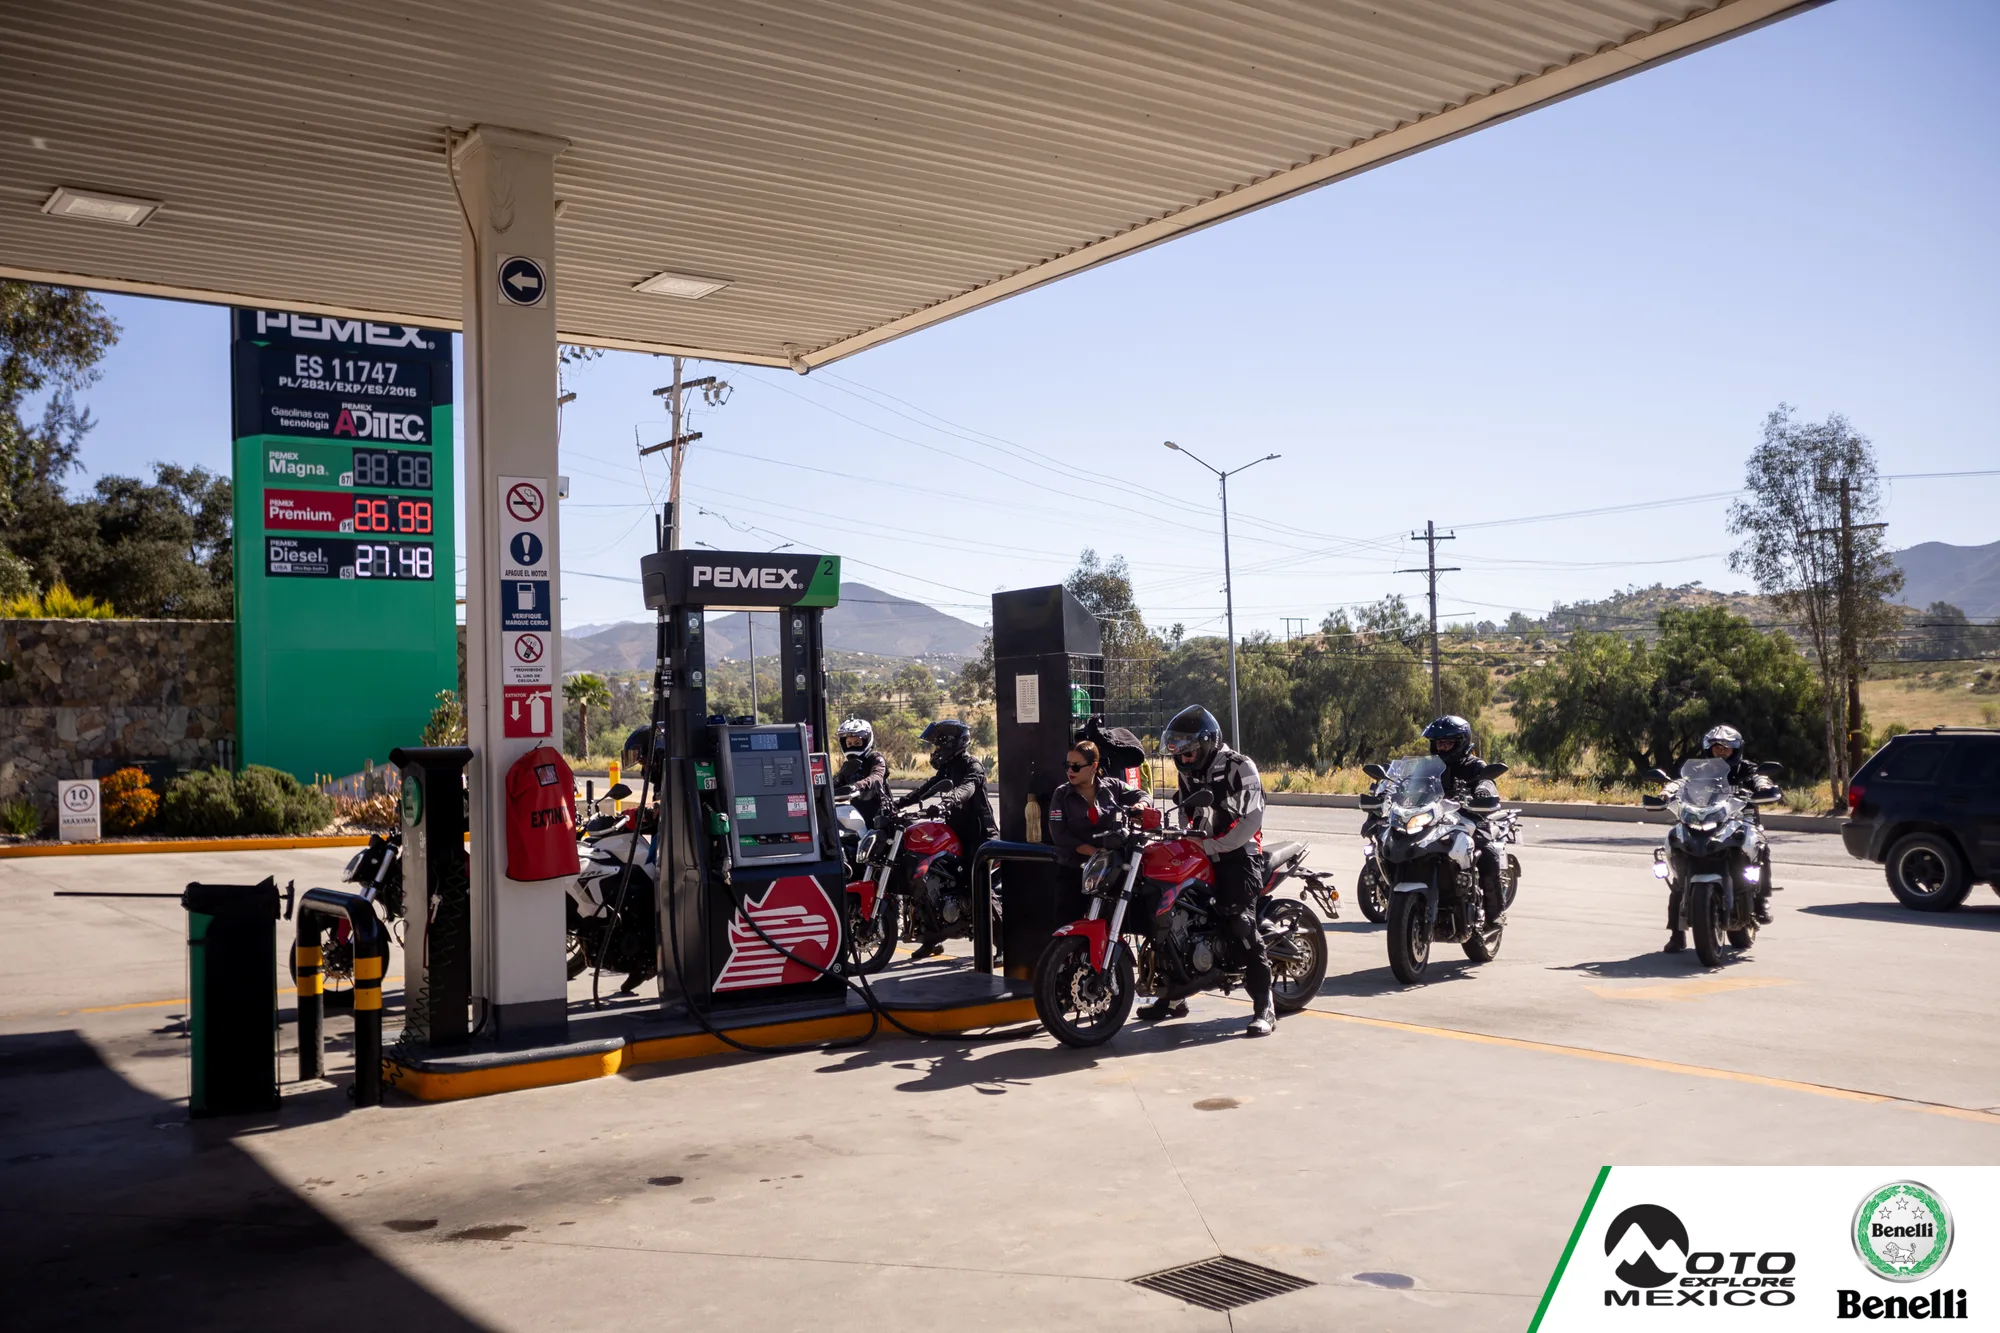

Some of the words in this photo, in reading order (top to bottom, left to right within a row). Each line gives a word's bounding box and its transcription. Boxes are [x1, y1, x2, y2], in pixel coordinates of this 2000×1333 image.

[257, 311, 427, 349] PEMEX
[295, 354, 323, 378] ES
[332, 358, 398, 384] 11747
[278, 376, 417, 398] PL/2821/EXP/ES/2015
[271, 406, 313, 419] Gasolinas
[314, 412, 329, 420] con
[342, 402, 372, 411] PEMEX
[268, 451, 299, 460] PEMEX
[268, 459, 325, 477] Magna
[269, 498, 294, 507] PEMEX
[269, 506, 332, 522] Premium
[355, 499, 432, 533] 26.99
[270, 539, 298, 548] PEMEX
[270, 547, 322, 563] Diesel
[355, 545, 433, 579] 27.48
[505, 569, 524, 577] APAGUE
[531, 570, 548, 578] MOTOR
[823, 560, 834, 576] 2
[693, 566, 798, 589] PEMEX
[70, 789, 88, 801] 10
